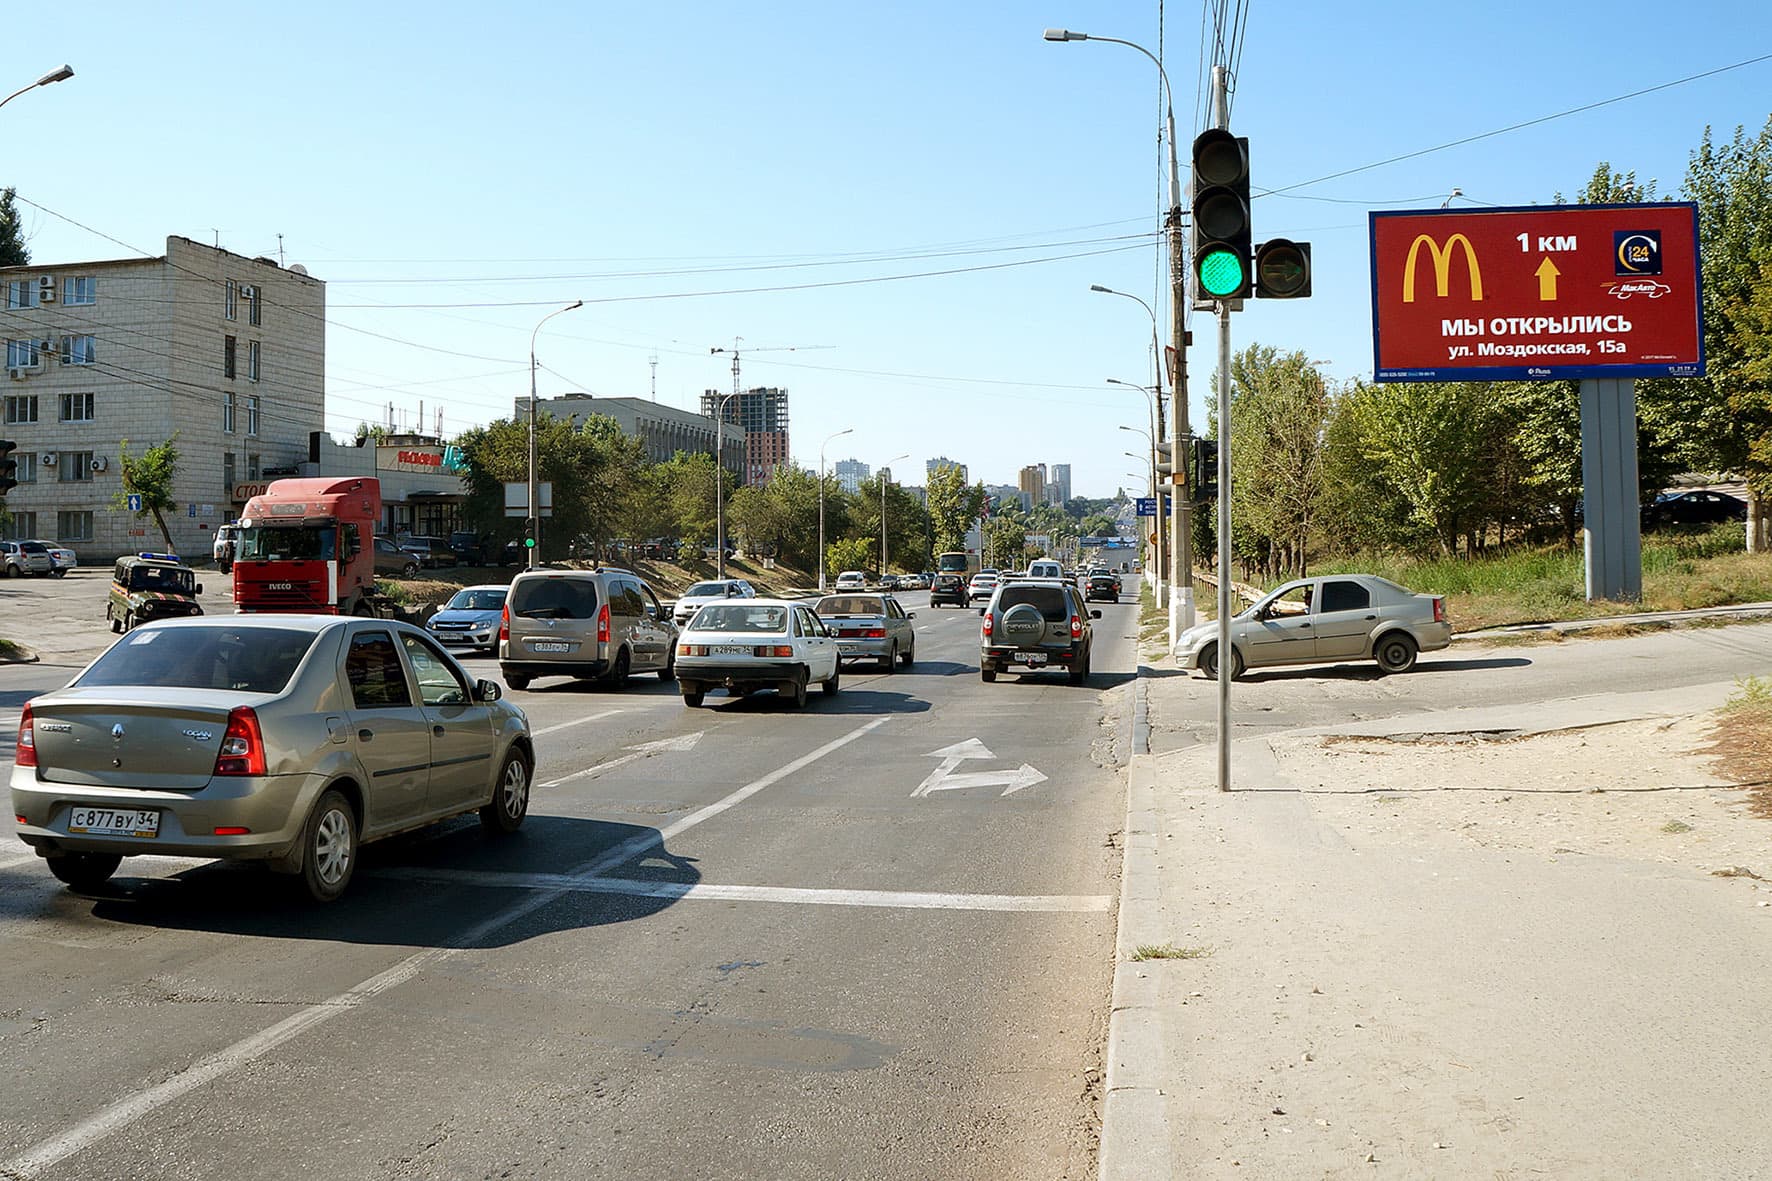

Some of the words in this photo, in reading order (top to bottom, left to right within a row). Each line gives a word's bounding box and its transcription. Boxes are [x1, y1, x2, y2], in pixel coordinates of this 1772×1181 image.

[1516, 233, 1529, 252] 1
[1632, 246, 1649, 258] 24
[1441, 319, 1484, 337] МЫ
[1490, 315, 1632, 336] ОТКРЫЛИСЬ
[1448, 345, 1474, 360] ул.
[1478, 342, 1591, 358] Моздокская,
[1596, 340, 1627, 353] 15а
[236, 485, 268, 498] СТОЛ
[75, 811, 134, 829] С877ВУ
[138, 812, 154, 826] 34
